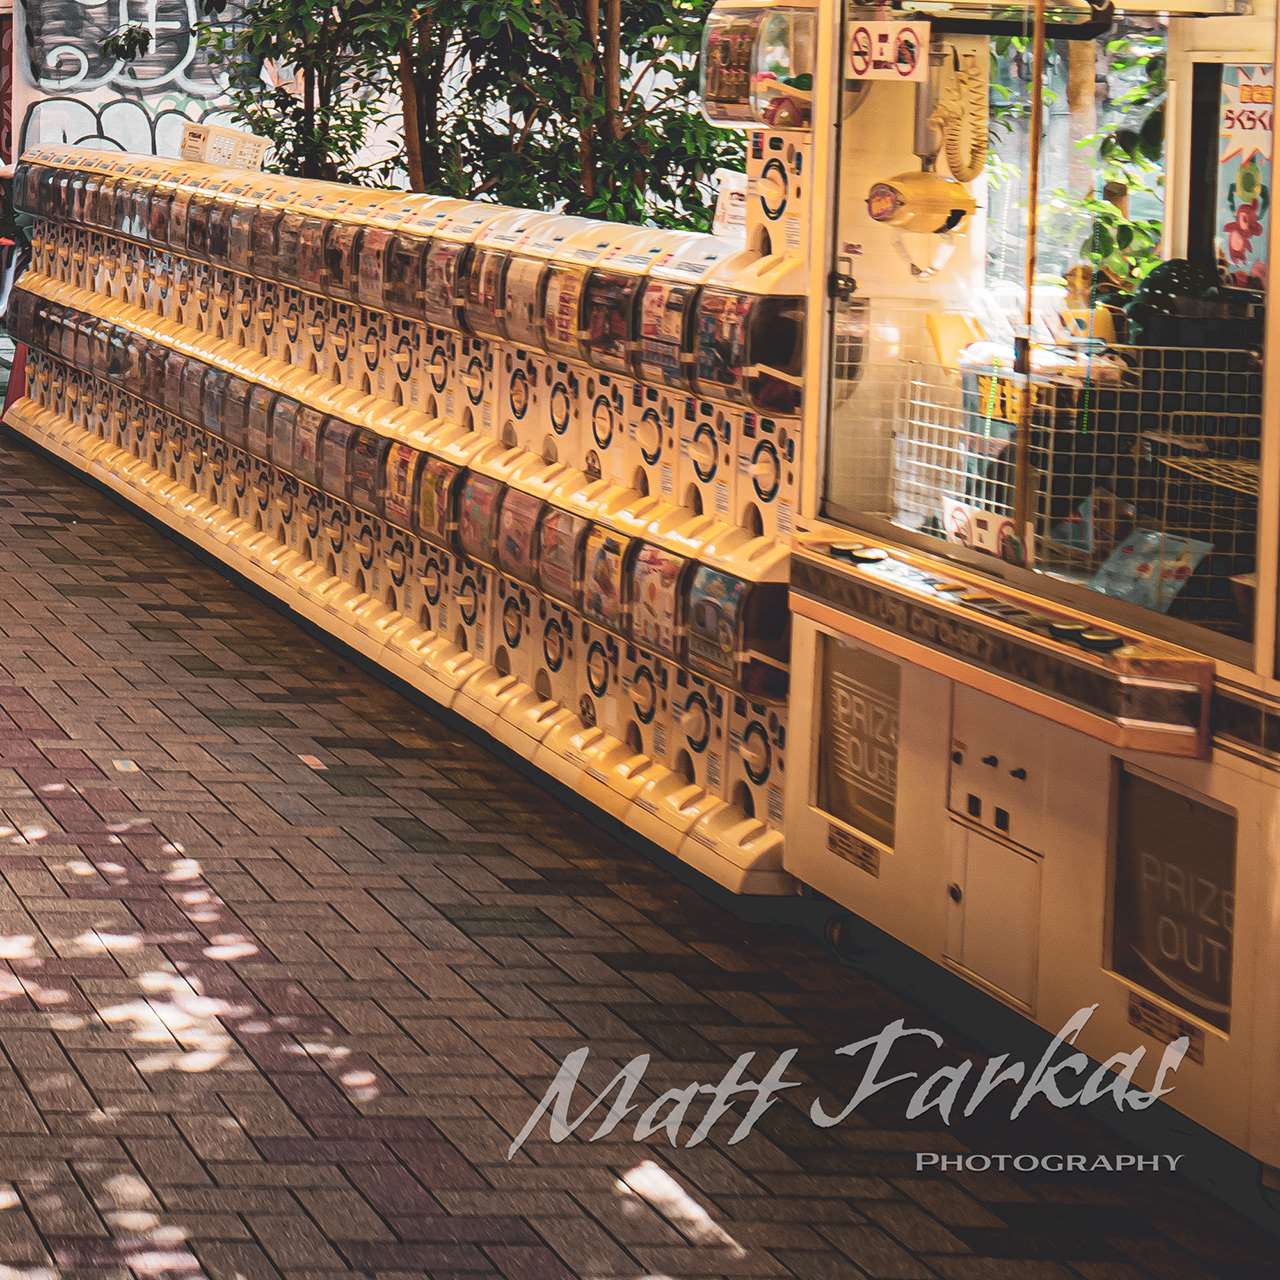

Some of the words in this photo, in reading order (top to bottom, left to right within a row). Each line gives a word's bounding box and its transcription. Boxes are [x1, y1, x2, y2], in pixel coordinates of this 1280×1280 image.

[1224, 109, 1273, 131] らくらく
[1158, 915, 1228, 984] OUT
